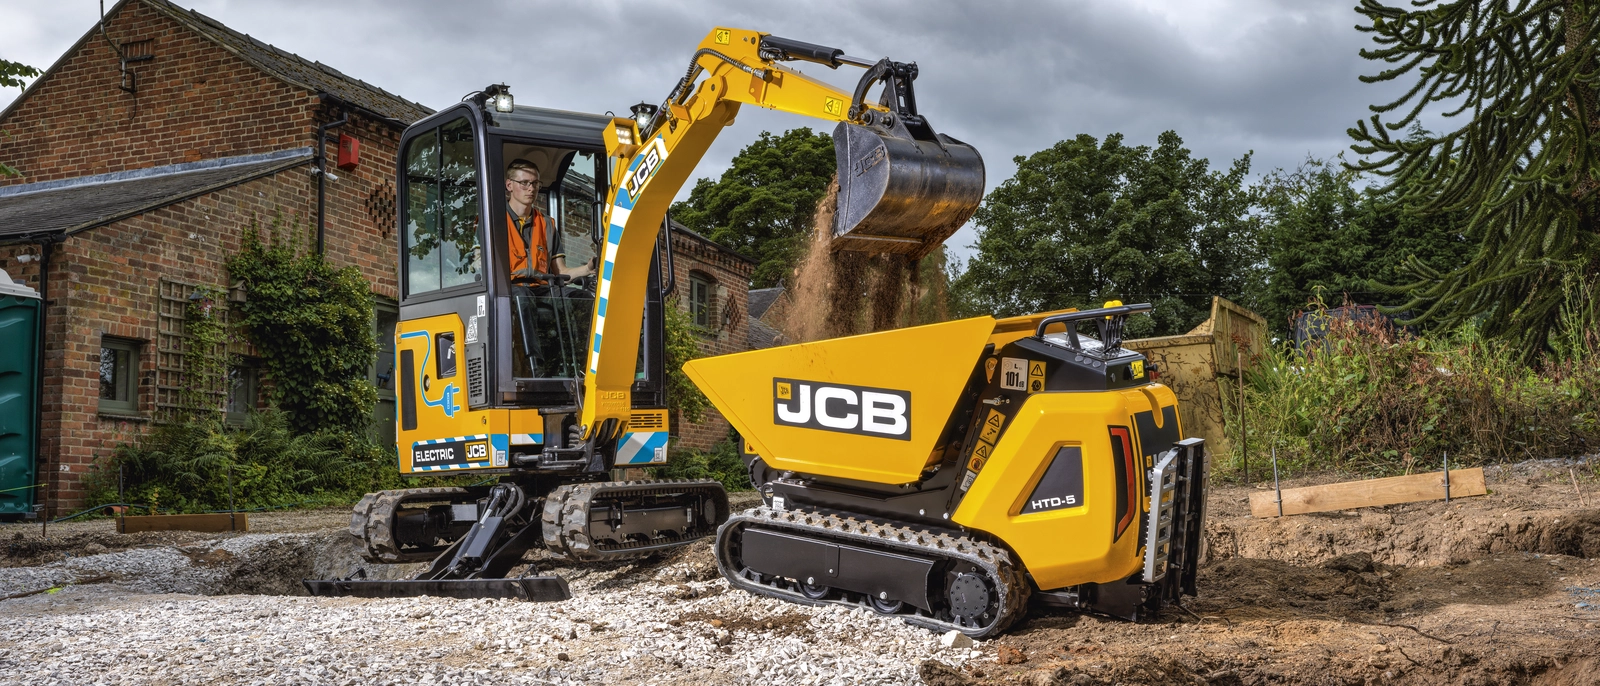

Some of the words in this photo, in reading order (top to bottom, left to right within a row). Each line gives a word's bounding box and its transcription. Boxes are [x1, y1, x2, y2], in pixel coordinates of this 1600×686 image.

[854, 145, 885, 177] JCB
[630, 148, 659, 197] JCB
[1006, 371, 1019, 387] 101
[601, 391, 626, 399] JCB
[777, 384, 908, 435] JCB
[415, 448, 454, 462] ELECTRIC
[467, 444, 487, 458] JCB
[1032, 494, 1076, 509] HTD-5
